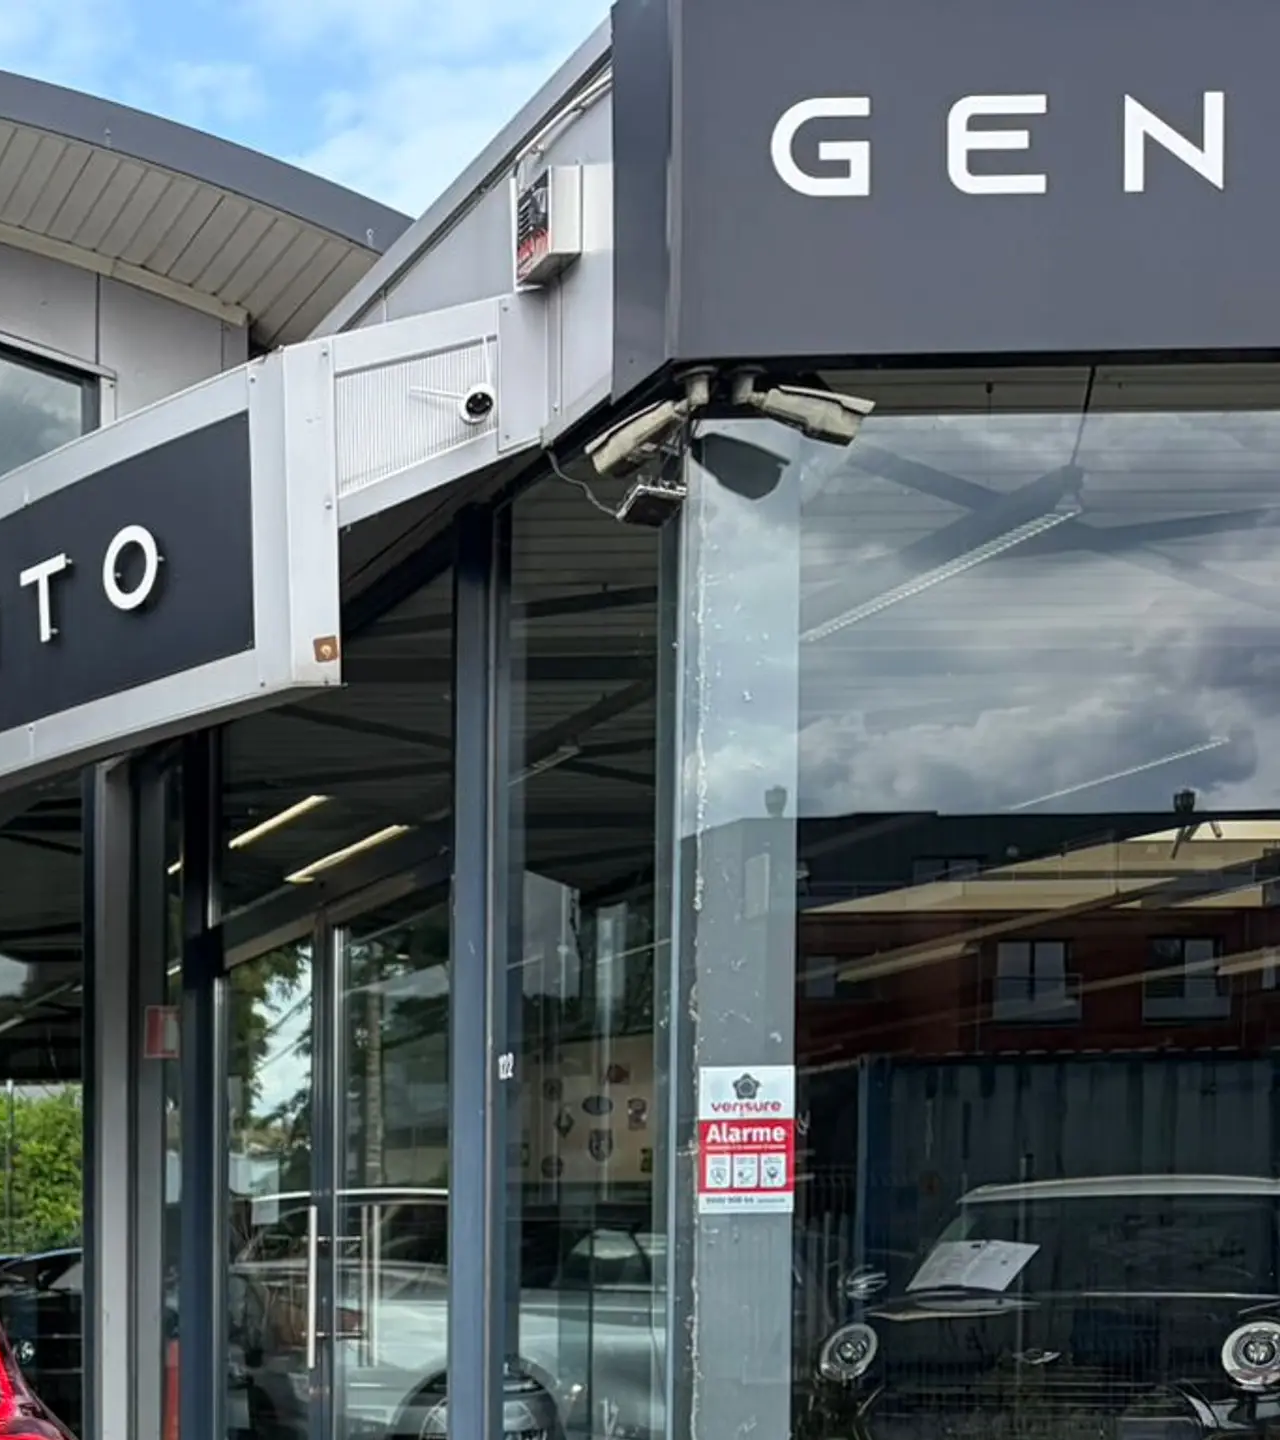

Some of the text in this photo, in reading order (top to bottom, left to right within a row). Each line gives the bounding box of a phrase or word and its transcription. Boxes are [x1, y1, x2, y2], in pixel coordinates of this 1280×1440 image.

[770, 91, 1224, 197] GEN
[711, 1100, 782, 1113] verisure
[706, 1122, 787, 1144] Alarme
